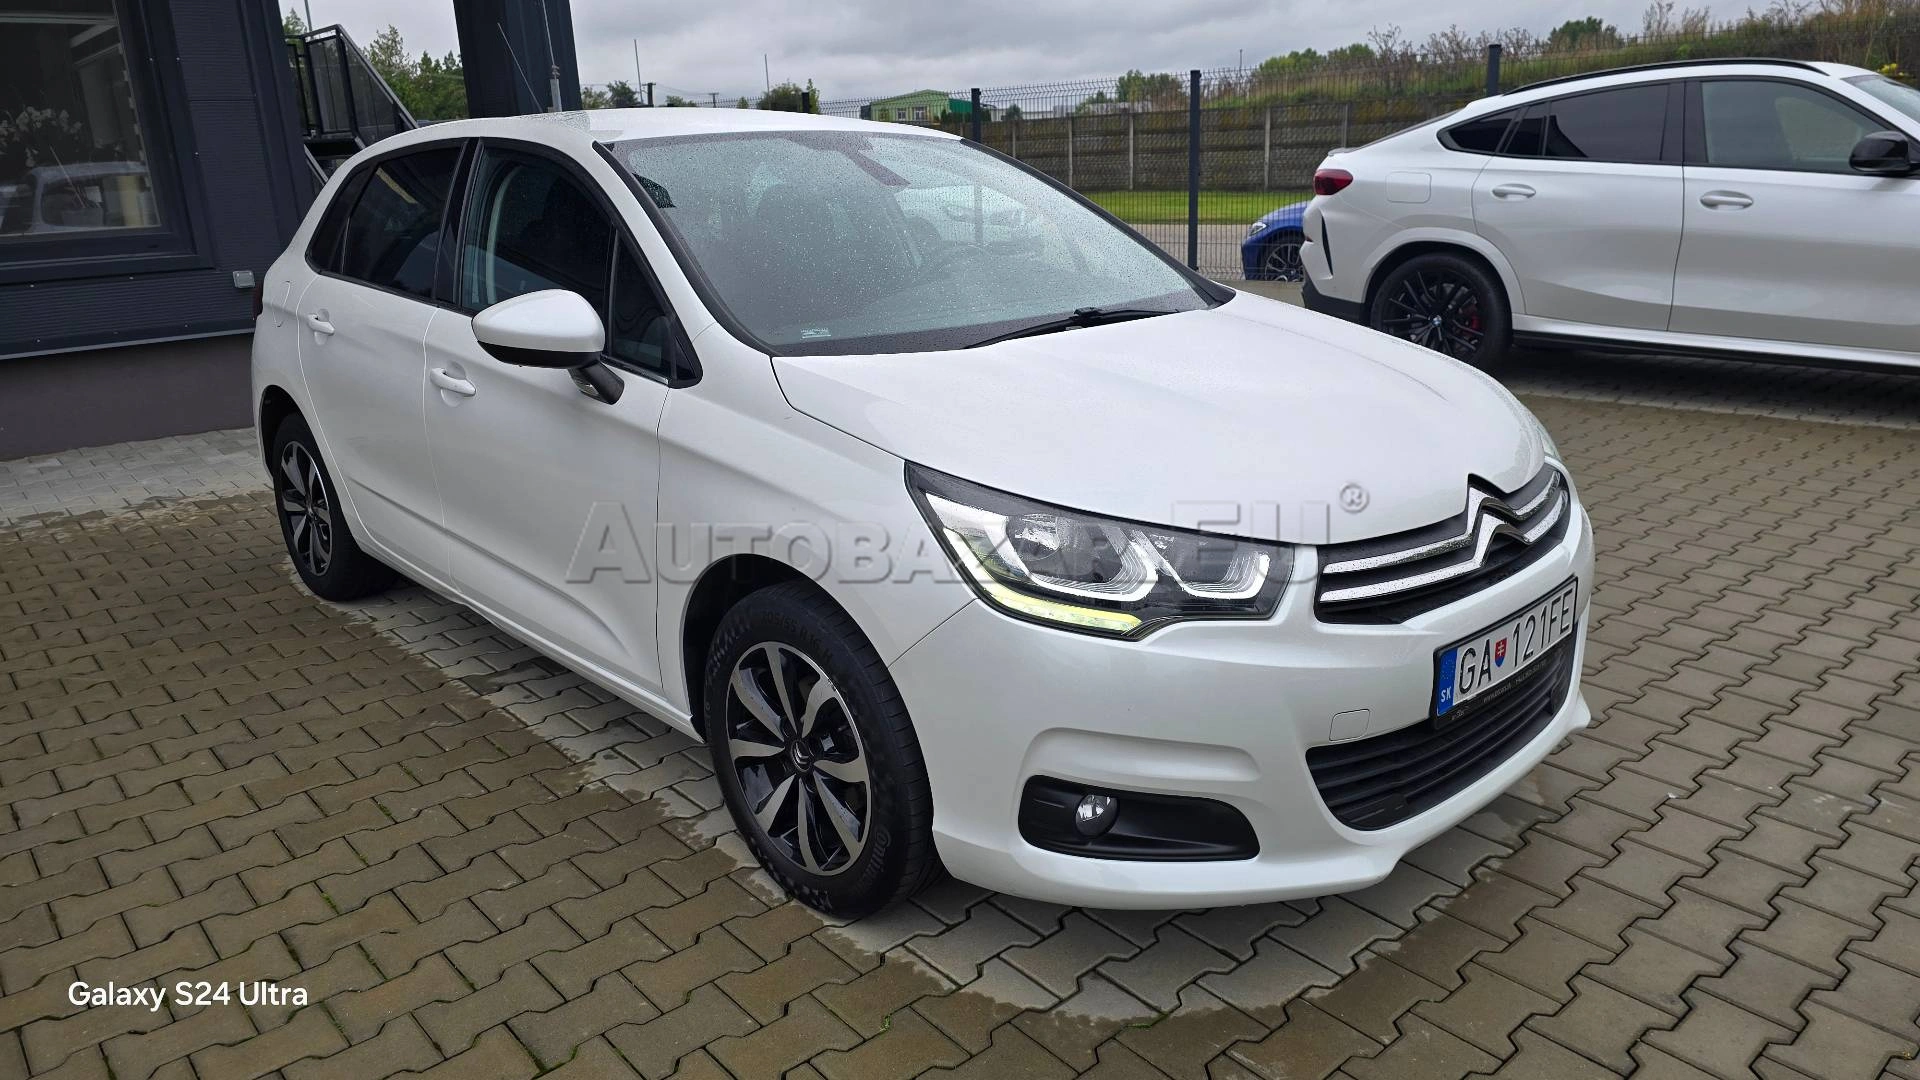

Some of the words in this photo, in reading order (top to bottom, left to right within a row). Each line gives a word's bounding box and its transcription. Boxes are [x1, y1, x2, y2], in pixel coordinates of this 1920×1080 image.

[1458, 638, 1492, 695] GA
[1512, 588, 1573, 668] 121FE
[1440, 686, 1452, 703] SK
